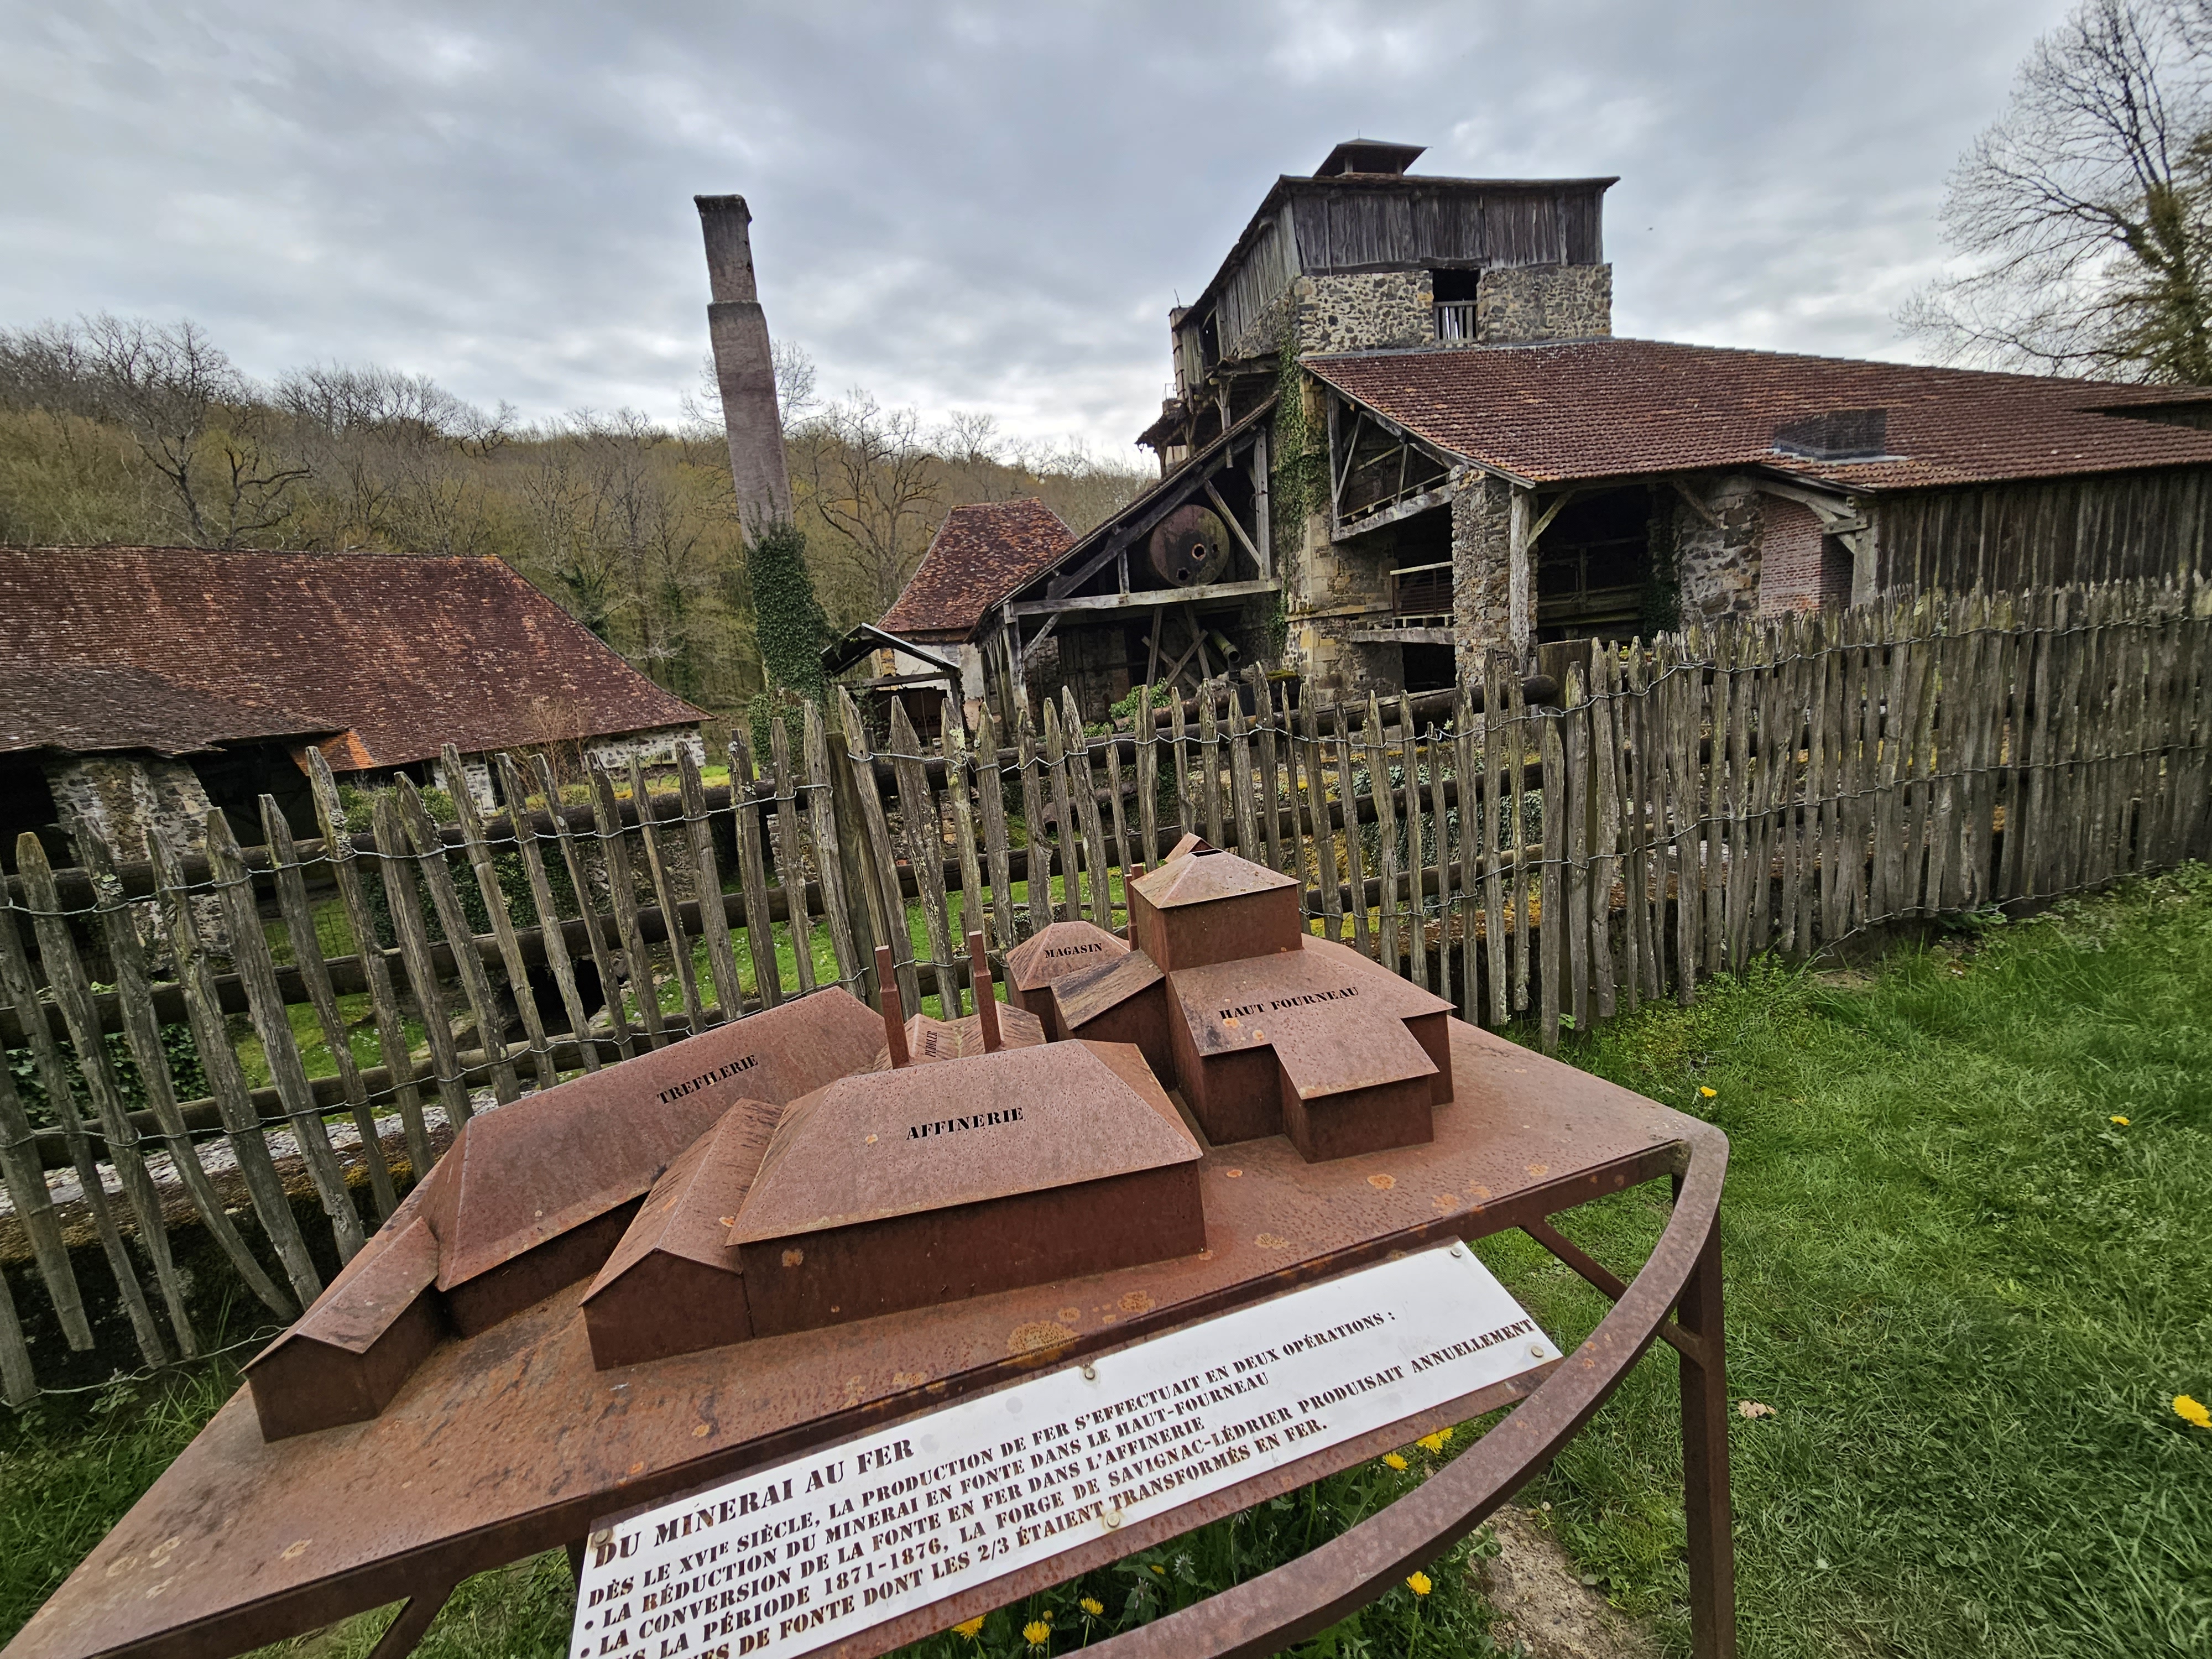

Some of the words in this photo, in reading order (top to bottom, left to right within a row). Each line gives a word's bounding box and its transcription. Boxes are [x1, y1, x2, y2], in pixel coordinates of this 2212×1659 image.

[1044, 942, 1103, 959] MAGASIN
[1218, 1003, 1265, 1020] HAUT
[1270, 986, 1360, 1011] FOURNEAU
[656, 1054, 759, 1105] TREFILERIE
[906, 1107, 1024, 1141] AFFINERIE
[588, 1575, 634, 1608] DÈS
[643, 1563, 670, 1588] LE
[737, 1511, 820, 1553] SIÈCLE,
[829, 1498, 854, 1520] LA
[862, 1448, 993, 1507] PRODUCTION
[1000, 1437, 1026, 1458] DE
[1031, 1423, 1070, 1446] FER
[1204, 1365, 1229, 1384] EN
[1232, 1349, 1280, 1374] DEUX
[1282, 1313, 1384, 1356] OPÉRATIONS
[592, 1531, 642, 1569] DU
[654, 1478, 793, 1547] MINERAI
[805, 1460, 844, 1494] AU
[857, 1439, 914, 1475] FER
[603, 1602, 632, 1629] LA
[641, 1547, 777, 1613] RÉDUCTION
[786, 1533, 816, 1559] DU
[825, 1497, 919, 1545] MINERAI
[925, 1485, 952, 1507] EN
[959, 1459, 1025, 1495] FONTE
[1030, 1438, 1082, 1469] DANS
[1087, 1428, 1111, 1448] LE
[1115, 1372, 1269, 1438] HAUT-FOURNEAU
[659, 1632, 689, 1659] LA
[702, 1585, 810, 1643] PÉRIODE
[825, 1537, 948, 1595] 1871-1876,
[959, 1521, 986, 1544] LA
[995, 1491, 1064, 1530] FORGE
[1072, 1478, 1100, 1500] DE
[1108, 1407, 1293, 1487] SAVIGNAC-LÉDRIER
[1297, 1365, 1404, 1414] PRODUISAIT
[1411, 1319, 1534, 1373] ANNUELLEMENT
[739, 1627, 770, 1657] DE
[779, 1594, 855, 1640] FONTE
[863, 1568, 923, 1607] DONT
[931, 1551, 970, 1580] LES
[977, 1537, 1009, 1563] 2/3
[1015, 1500, 1104, 1547] ÉTAIENT
[1108, 1444, 1251, 1512] TRANSFORMÉS
[1253, 1433, 1281, 1454] EN
[1283, 1419, 1327, 1443] FER.
[599, 1629, 629, 1656] LA
[639, 1567, 791, 1639] CONVERSION
[800, 1553, 829, 1579] DE
[837, 1542, 864, 1564] LA
[872, 1512, 941, 1552] FONTE
[947, 1500, 974, 1523] EN
[982, 1484, 1022, 1510] FER
[1027, 1462, 1081, 1493] DANS
